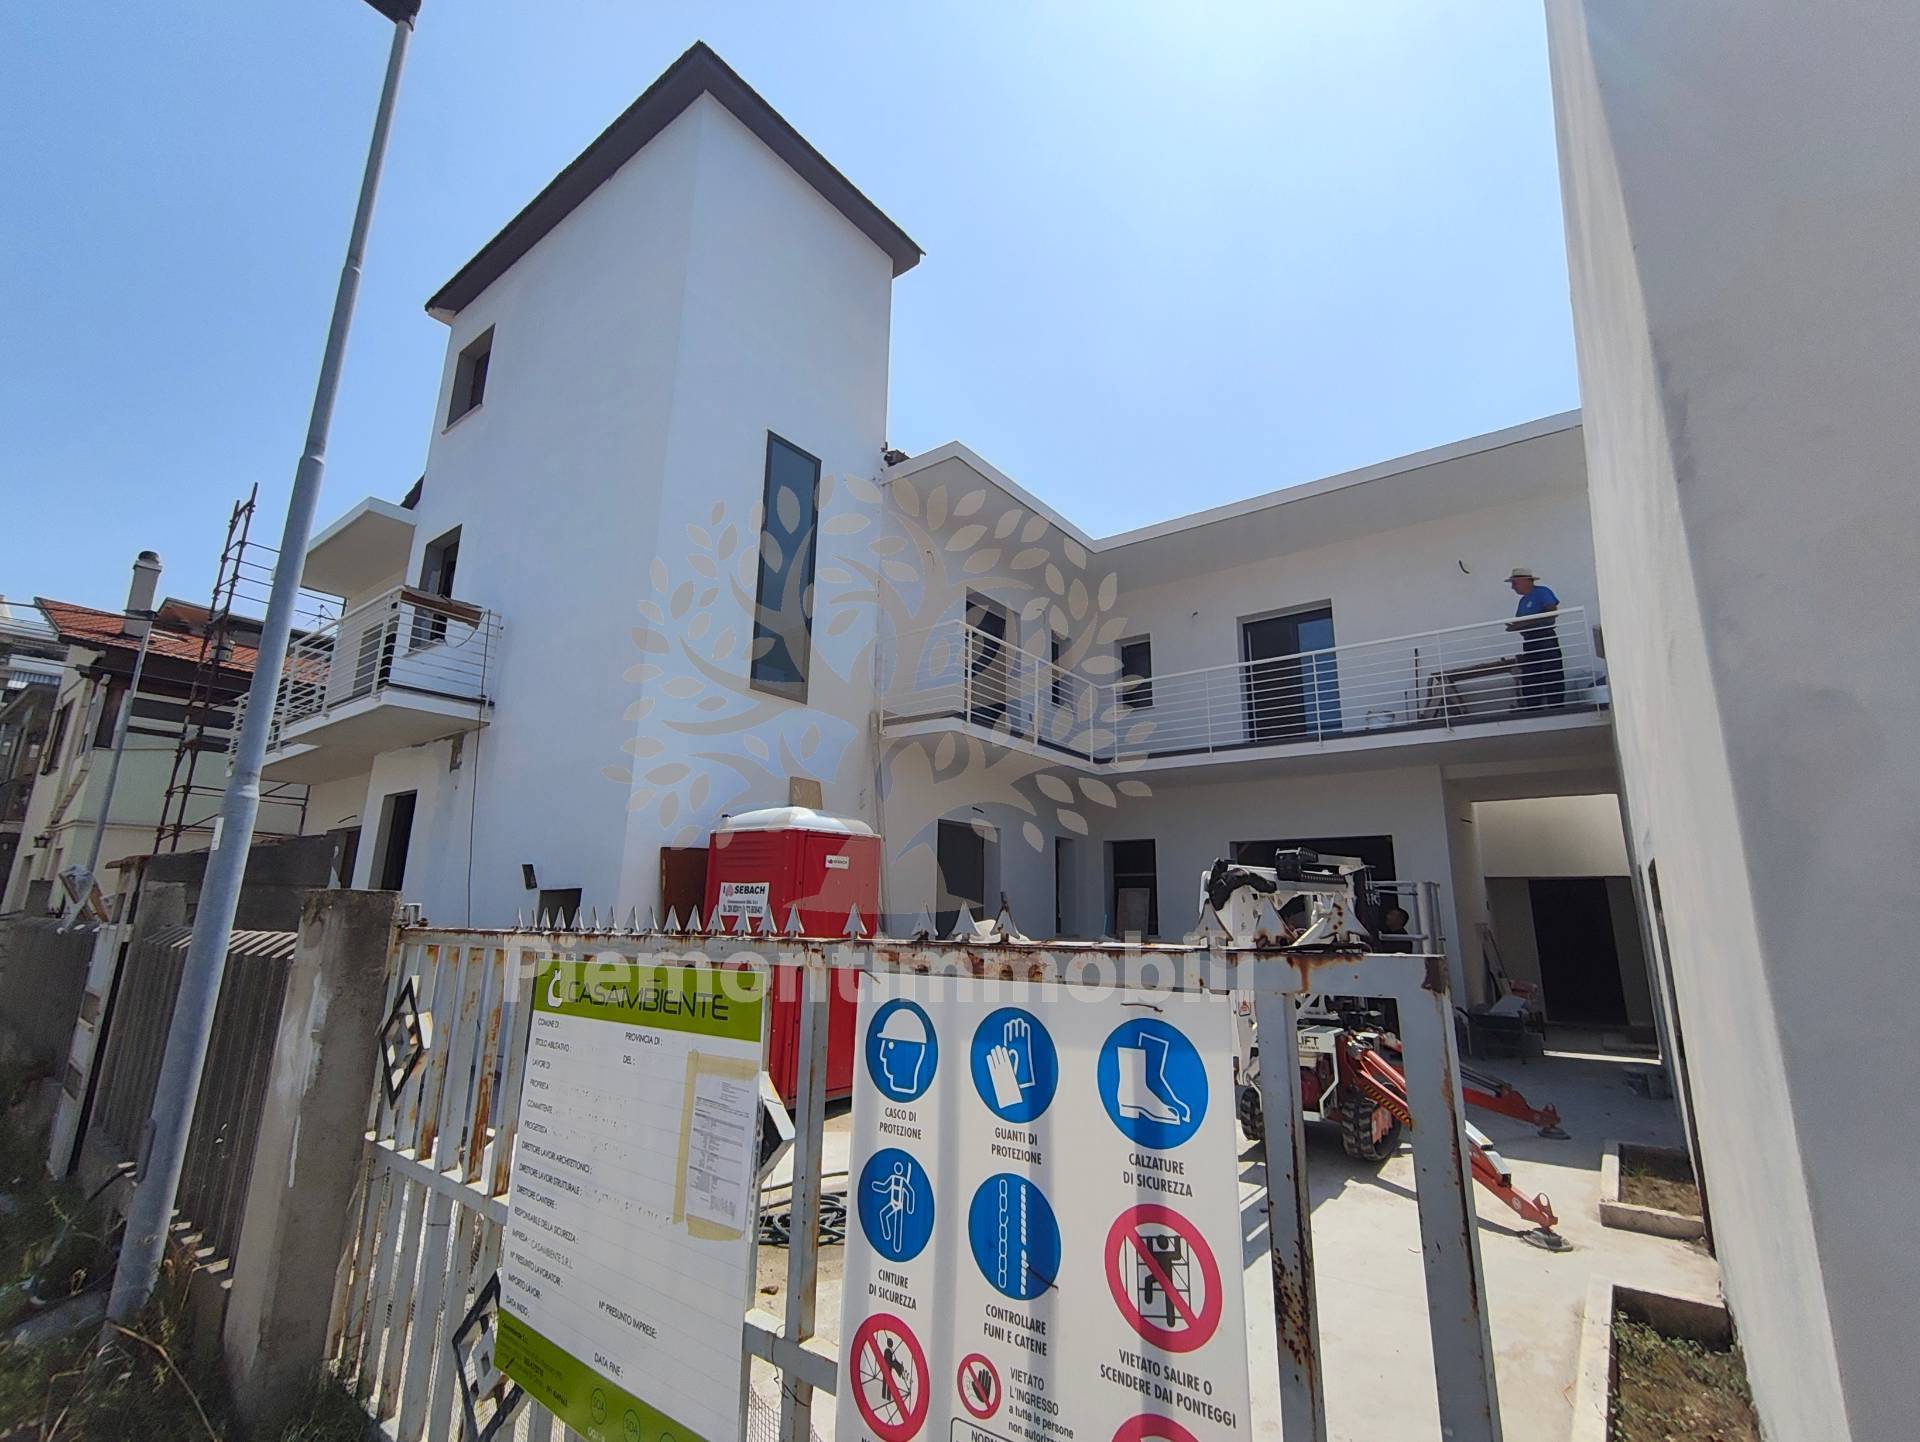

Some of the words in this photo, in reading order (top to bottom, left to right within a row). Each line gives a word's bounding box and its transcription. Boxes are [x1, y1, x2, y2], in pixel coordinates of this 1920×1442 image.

[734, 886, 766, 895] SEBACH
[568, 980, 729, 1021] CASAMBIENTE
[625, 1032, 652, 1045] PROVINCIA
[653, 1036, 660, 1045] DI
[622, 1054, 632, 1065] DEL
[884, 1107, 907, 1121] CASCO
[908, 1111, 917, 1123] DI
[879, 1121, 922, 1140] PROTEZIONE
[994, 1127, 1026, 1143] GUANTI
[1028, 1132, 1038, 1146] DI
[991, 1143, 1042, 1165] PROTEZIONE
[1128, 1153, 1184, 1175] CALZATURE
[1123, 1171, 1134, 1185] DI
[1136, 1173, 1193, 1197] SICUREZZA
[878, 1269, 909, 1289] CINTURE
[868, 1283, 877, 1296] DI
[878, 1286, 917, 1310] SICUREZZA
[605, 1303, 633, 1326] PRESUNTO
[985, 1304, 1046, 1336] CONTROLLARE
[983, 1322, 1005, 1342] FUNI
[1006, 1330, 1012, 1344] E
[1014, 1333, 1047, 1357] CATENE
[594, 1352, 608, 1368] DATA
[608, 1361, 621, 1377] FINE
[1118, 1348, 1161, 1377] VIETATO
[1163, 1365, 1200, 1392] SALIRE
[1203, 1380, 1213, 1396] O
[1010, 1367, 1045, 1391] VIETATO
[1009, 1385, 1059, 1416] L'INGRESSO
[1099, 1364, 1151, 1396] SCENDERE
[1154, 1384, 1173, 1405] DAI
[1176, 1392, 1237, 1429] PONTEGGI
[1008, 1405, 1014, 1414] a
[1015, 1405, 1032, 1422] tutte
[1033, 1411, 1041, 1426] le
[1042, 1417, 1074, 1440] persone
[1008, 1421, 1023, 1435] non
